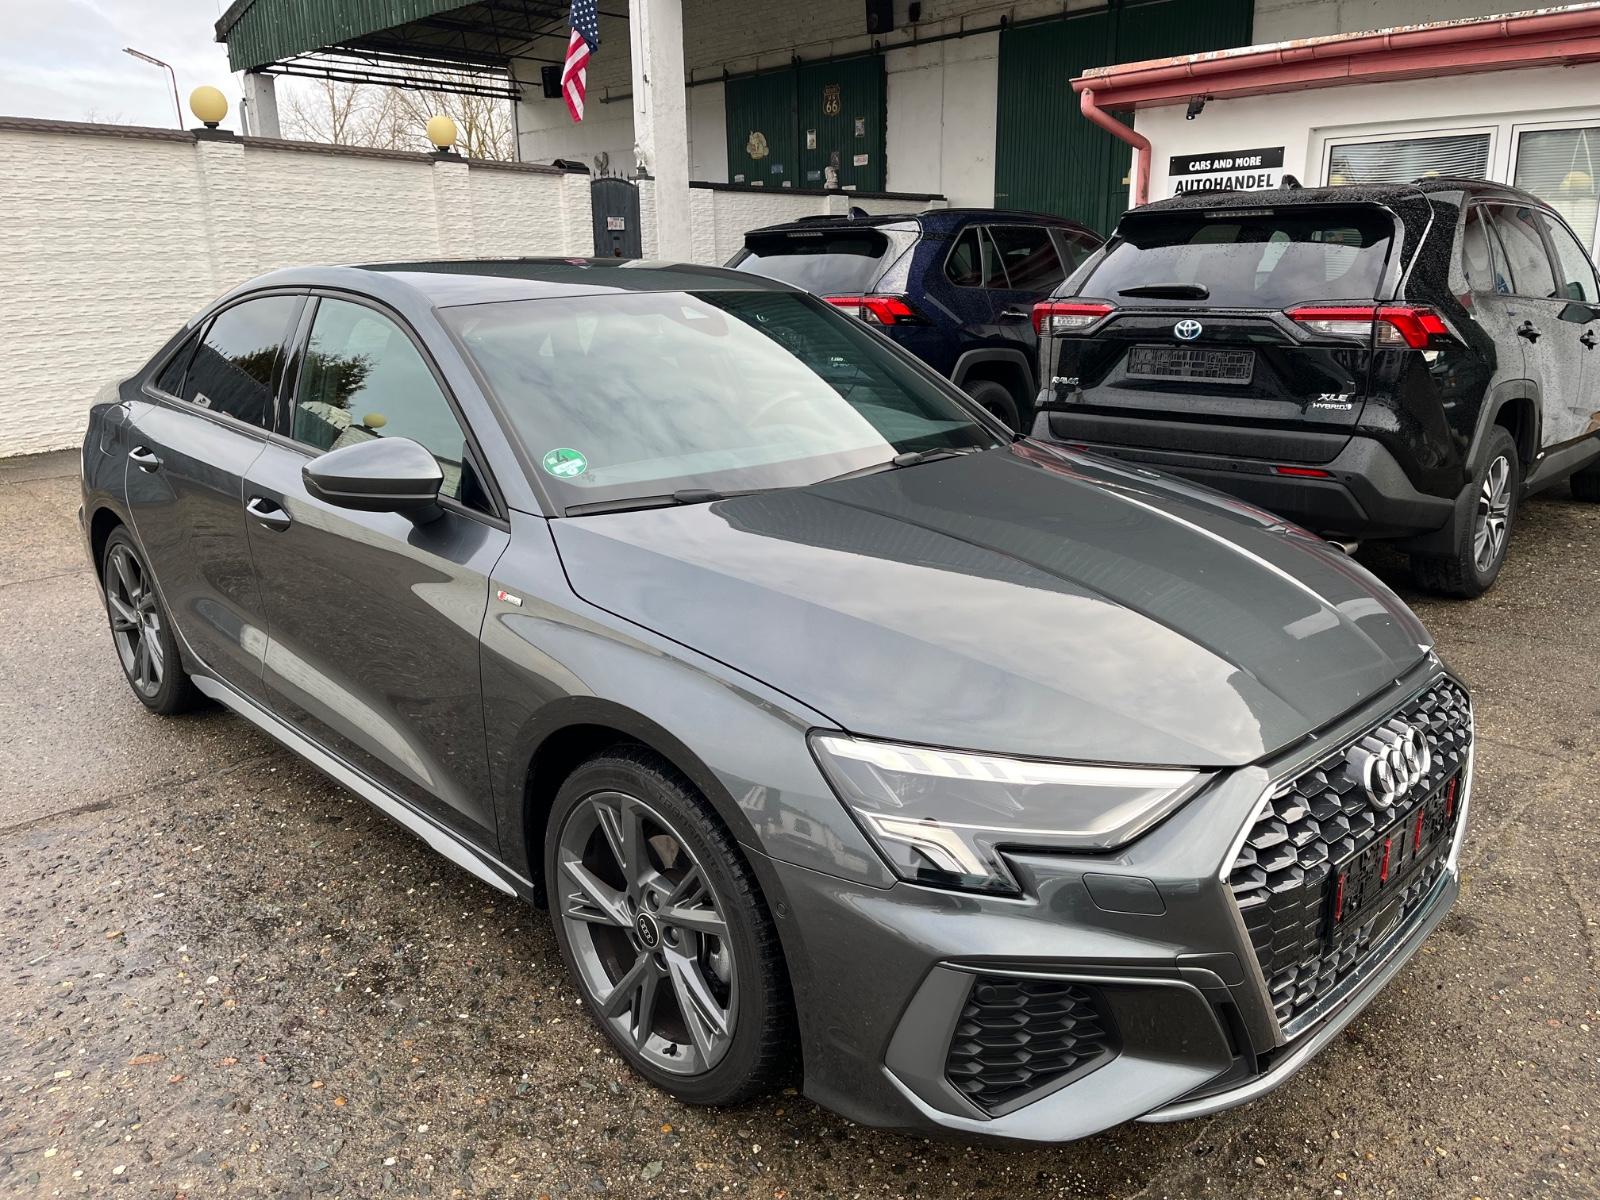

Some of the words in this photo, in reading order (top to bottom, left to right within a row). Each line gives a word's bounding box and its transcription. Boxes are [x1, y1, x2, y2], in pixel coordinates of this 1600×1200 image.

[826, 100, 838, 113] 66
[1189, 160, 1211, 171] CARS
[1212, 158, 1233, 169] AND
[1235, 156, 1262, 167] MORE
[1175, 173, 1274, 194] AUTOHANDEL
[1317, 393, 1349, 402] XLE
[556, 451, 569, 463] 4
